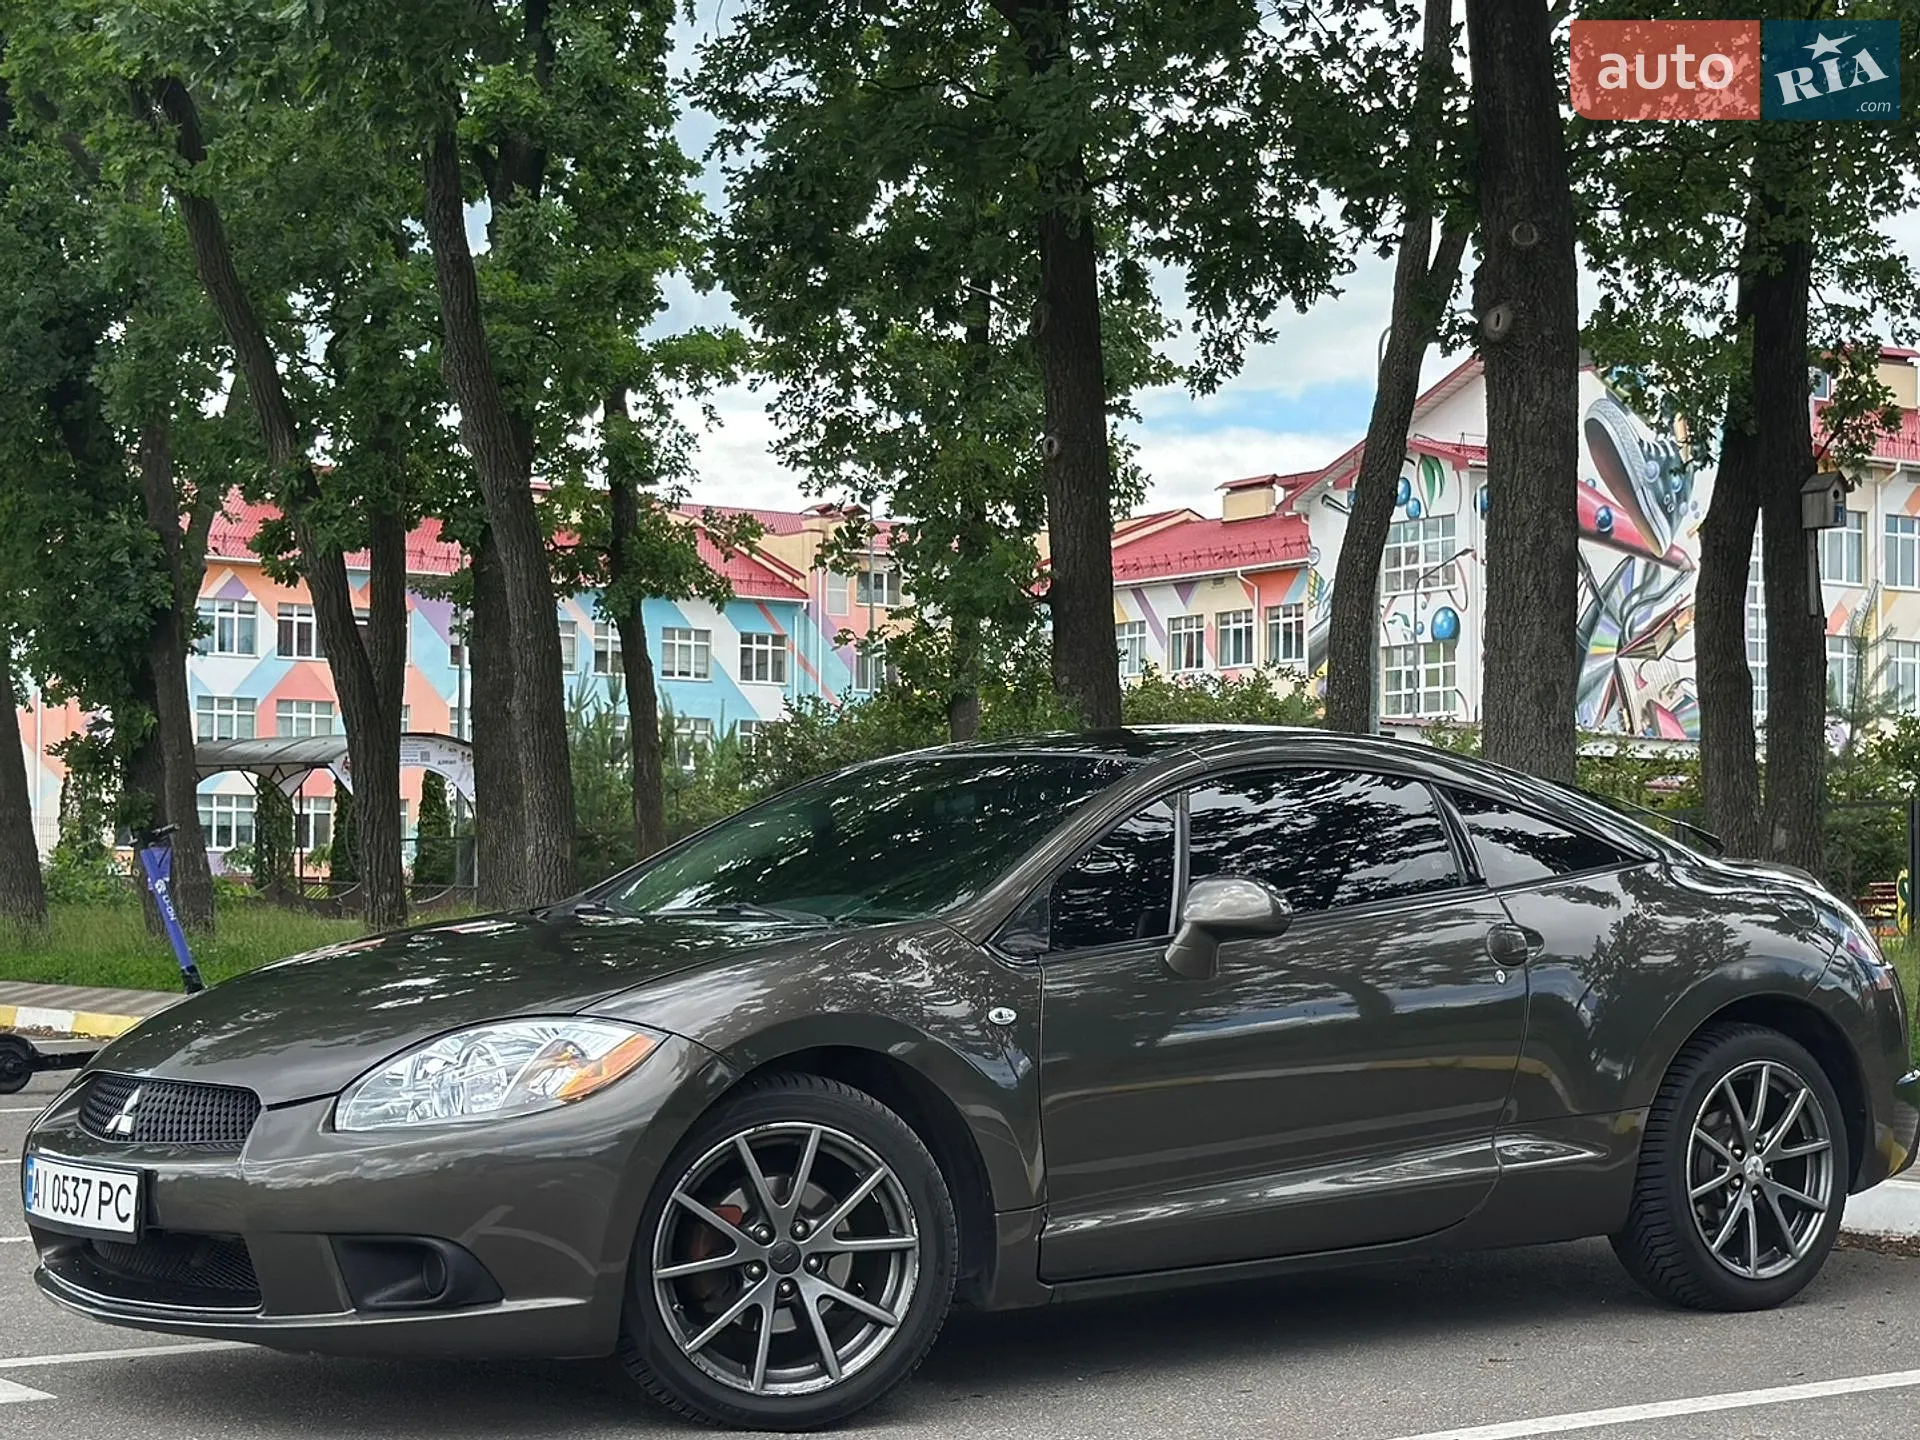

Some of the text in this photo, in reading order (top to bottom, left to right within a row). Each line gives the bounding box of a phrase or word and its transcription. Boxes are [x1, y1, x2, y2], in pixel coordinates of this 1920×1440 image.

[33, 1167, 48, 1209] AI
[52, 1173, 92, 1218] 0537
[97, 1180, 132, 1223] PC
